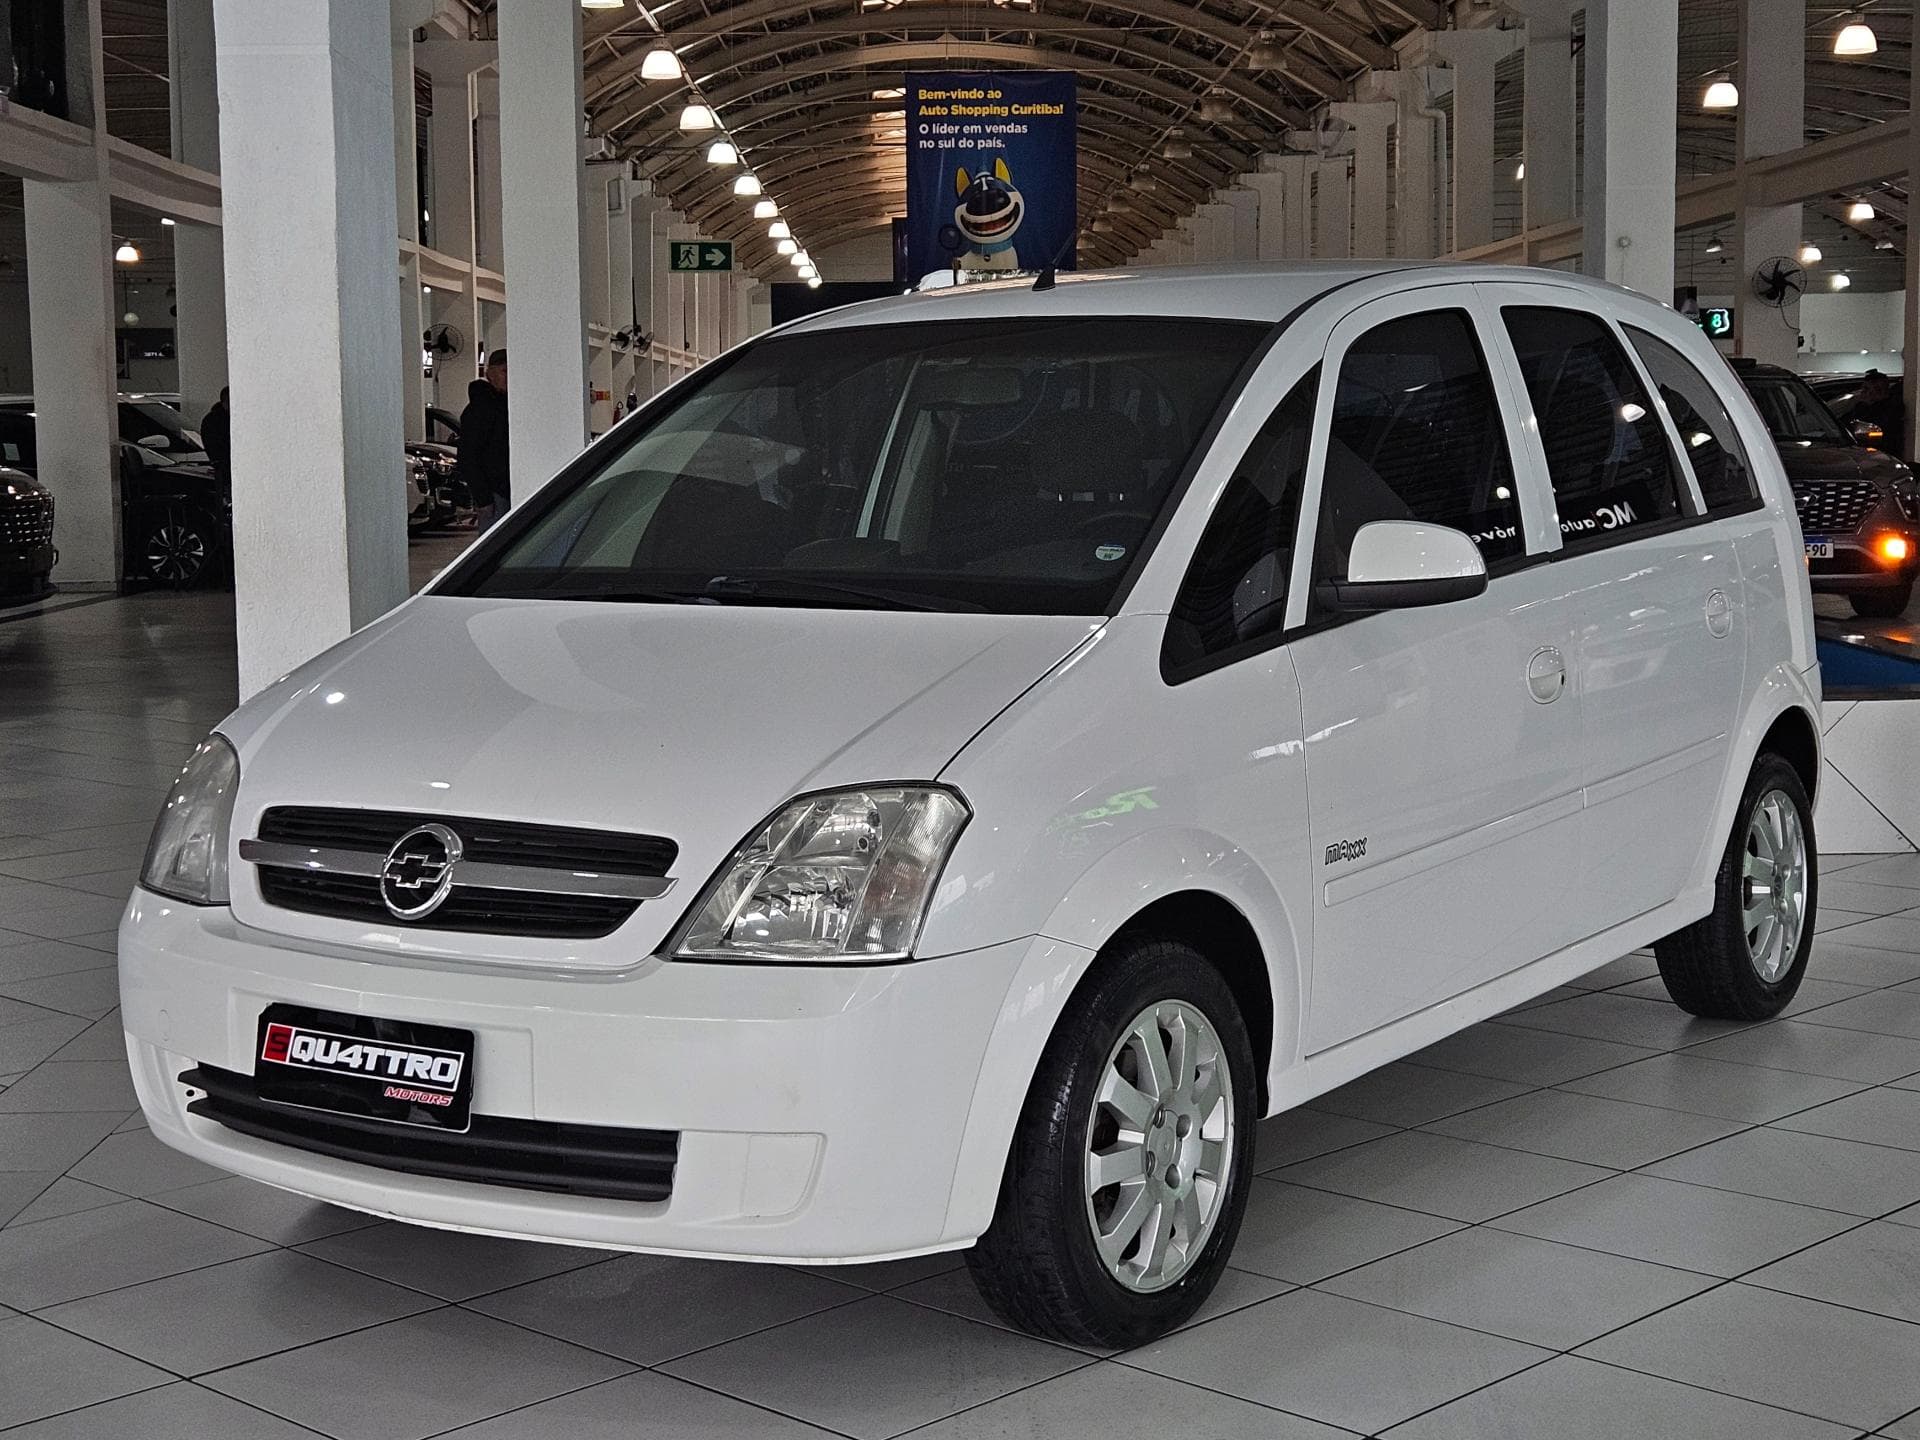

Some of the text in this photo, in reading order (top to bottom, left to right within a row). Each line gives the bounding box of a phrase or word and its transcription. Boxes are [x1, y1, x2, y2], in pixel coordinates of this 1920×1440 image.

[918, 88, 1002, 99] Bem-vindo ao
[919, 103, 1064, 117] Auto Shopping Curitiba!
[919, 122, 1028, 134] O líder em vendas
[919, 136, 1006, 150] no sul do país.
[384, 1086, 454, 1107] MOTORS
